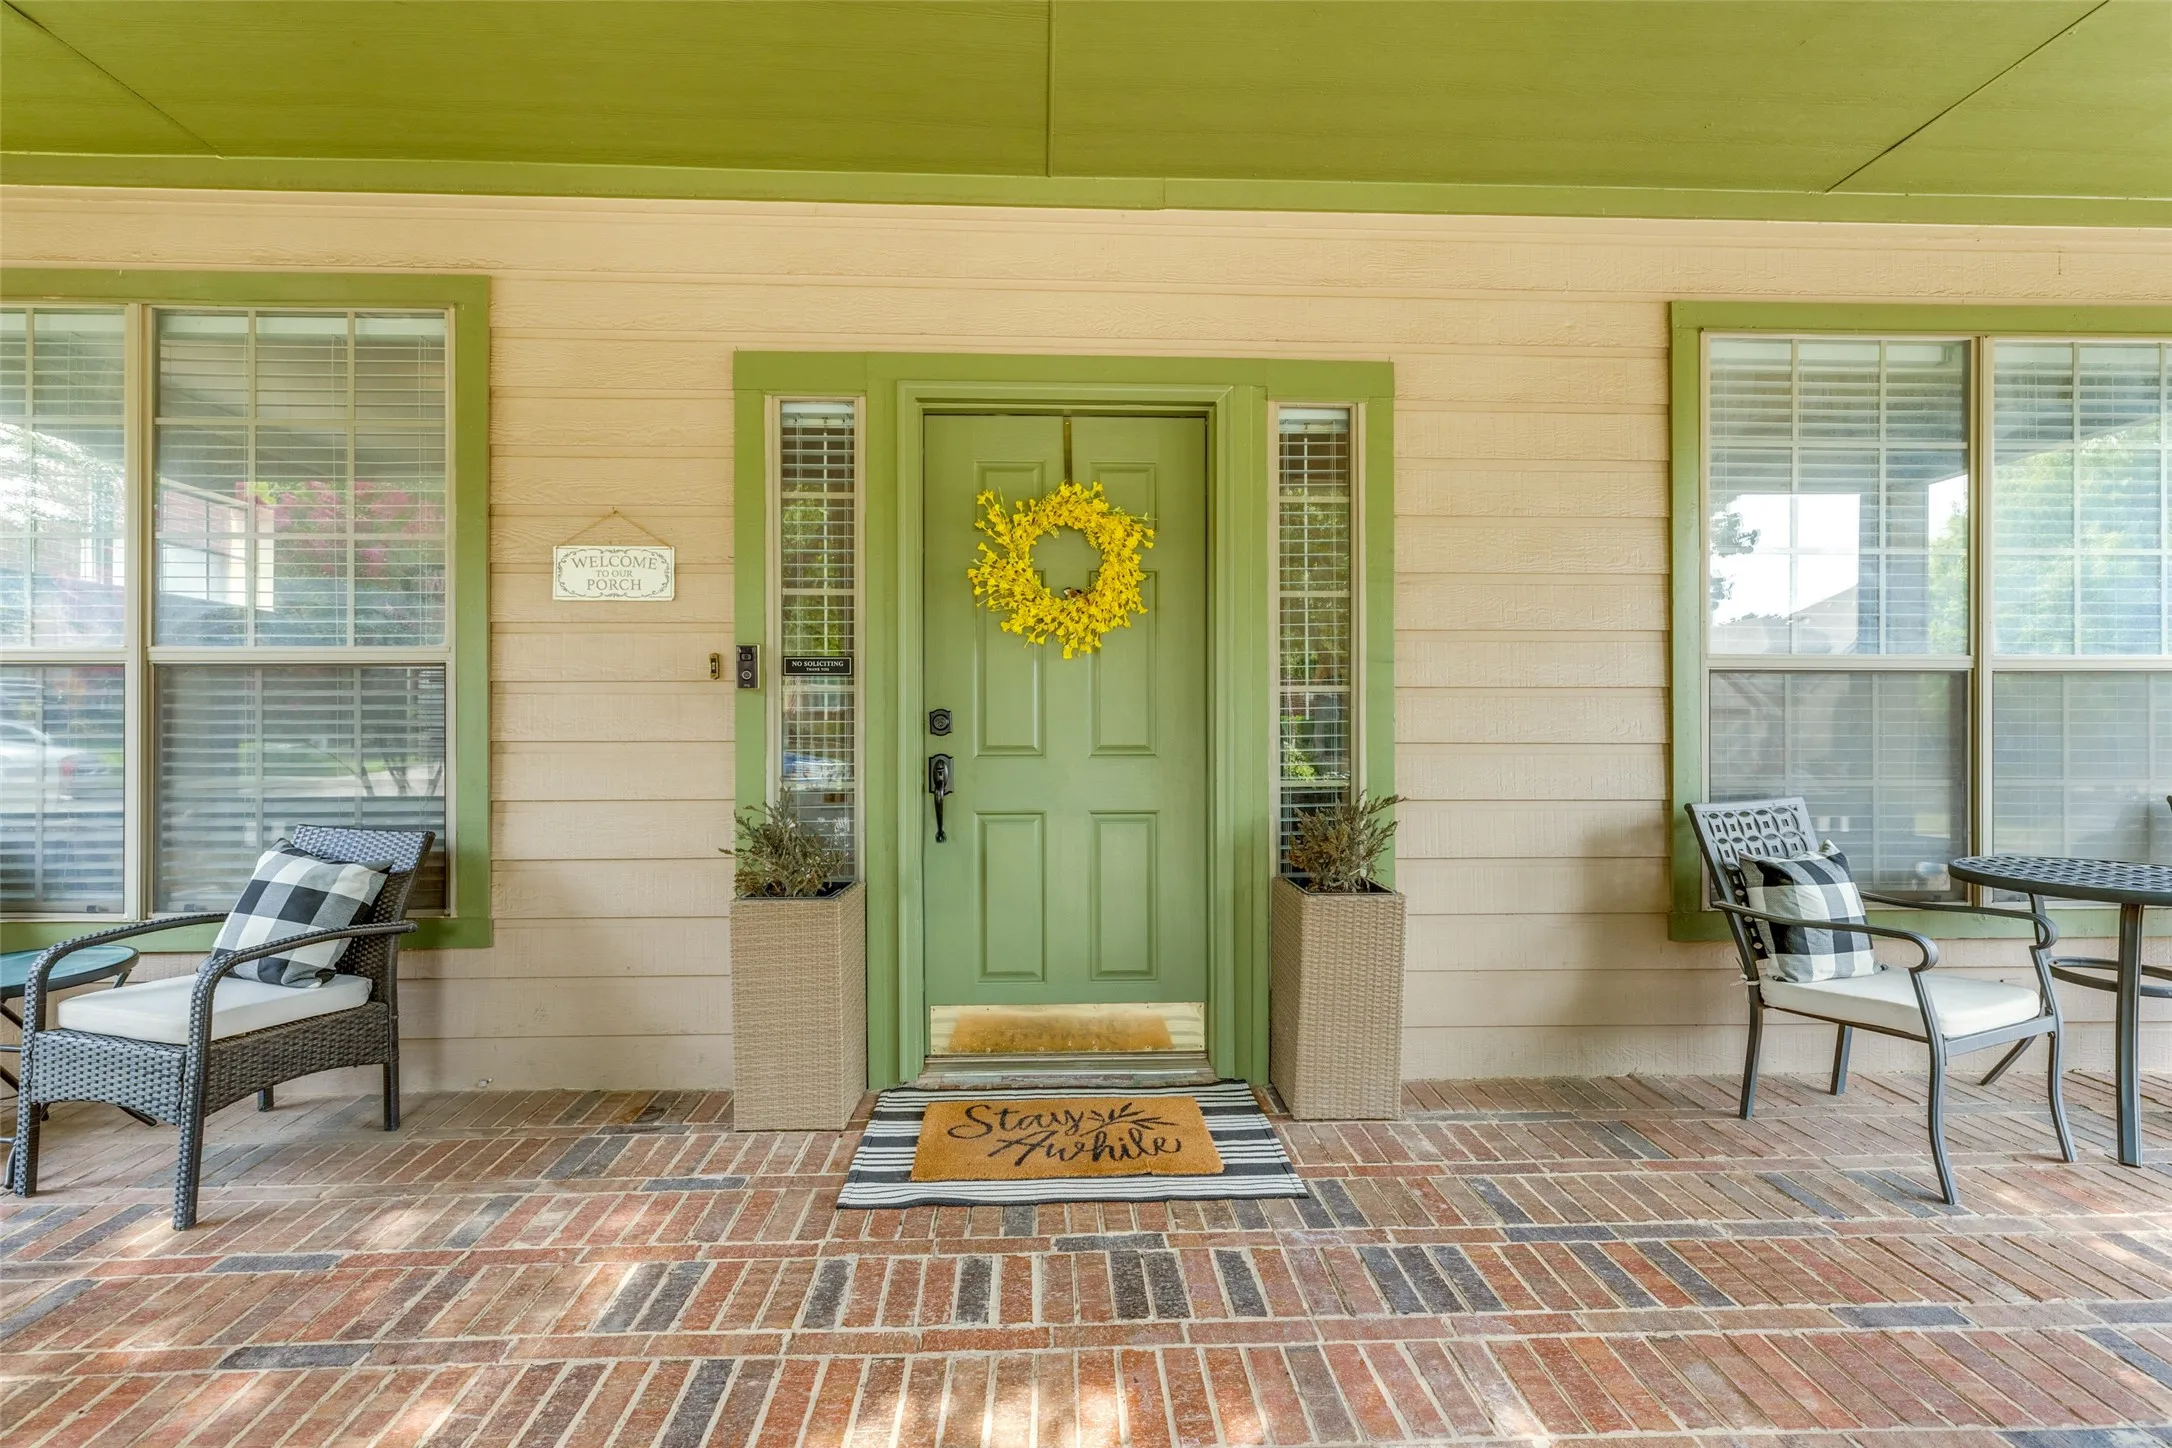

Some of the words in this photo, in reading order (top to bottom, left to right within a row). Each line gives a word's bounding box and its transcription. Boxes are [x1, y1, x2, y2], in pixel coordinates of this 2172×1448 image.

[571, 555, 657, 569] WELCOME
[596, 570, 610, 578] TO
[611, 570, 633, 578] OUR
[587, 579, 641, 590] PORCH
[948, 1104, 1084, 1139] Stay
[987, 1128, 1182, 1167] Awhile
